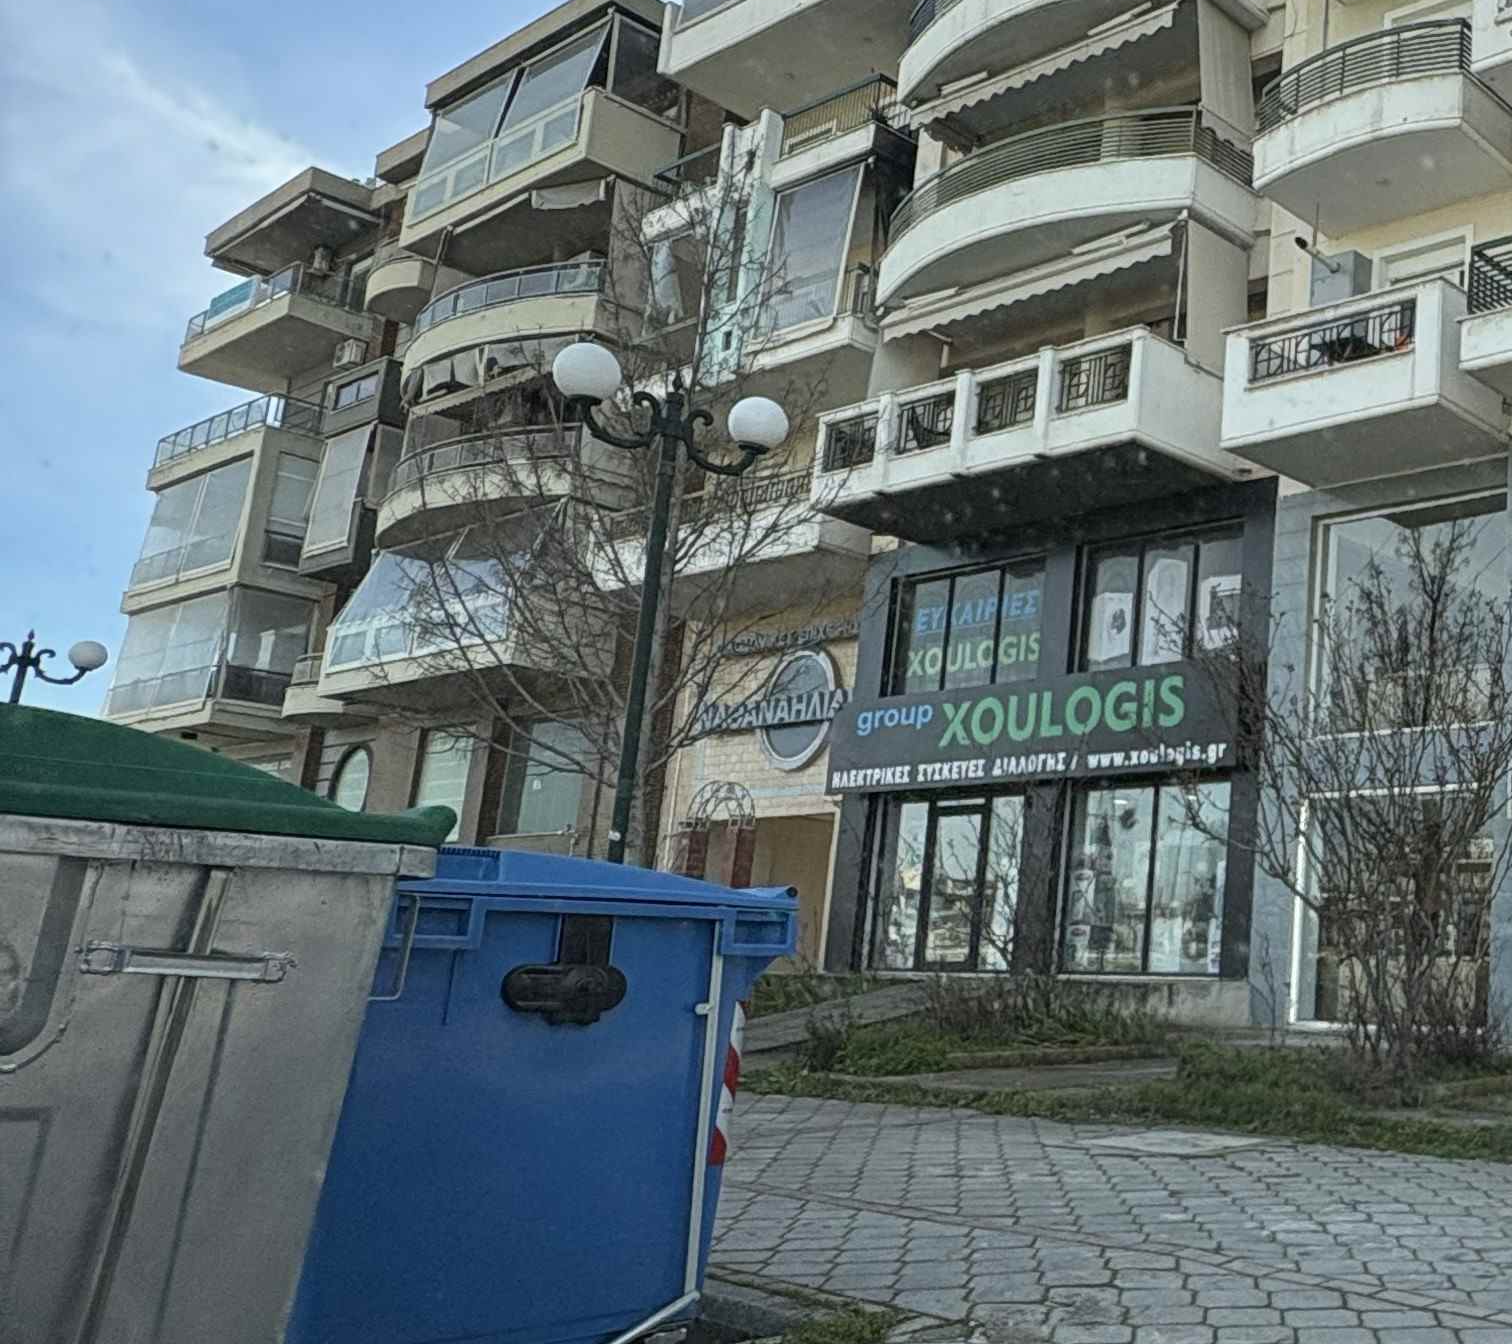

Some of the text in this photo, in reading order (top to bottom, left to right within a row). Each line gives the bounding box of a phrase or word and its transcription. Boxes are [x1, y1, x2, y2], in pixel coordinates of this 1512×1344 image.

[906, 631, 1041, 677] XOULOGIS
[856, 674, 1186, 748] group XOULOGIS
[831, 764, 911, 789] ΗΛΕΚΤΡΙΚΕΣ
[916, 759, 986, 783] ΣΥΣΚΕΥΕΣ
[991, 751, 1067, 777] ΔΙΑΛΟΓΗΣ
[1087, 740, 1228, 770] www.xoulogis.gr
